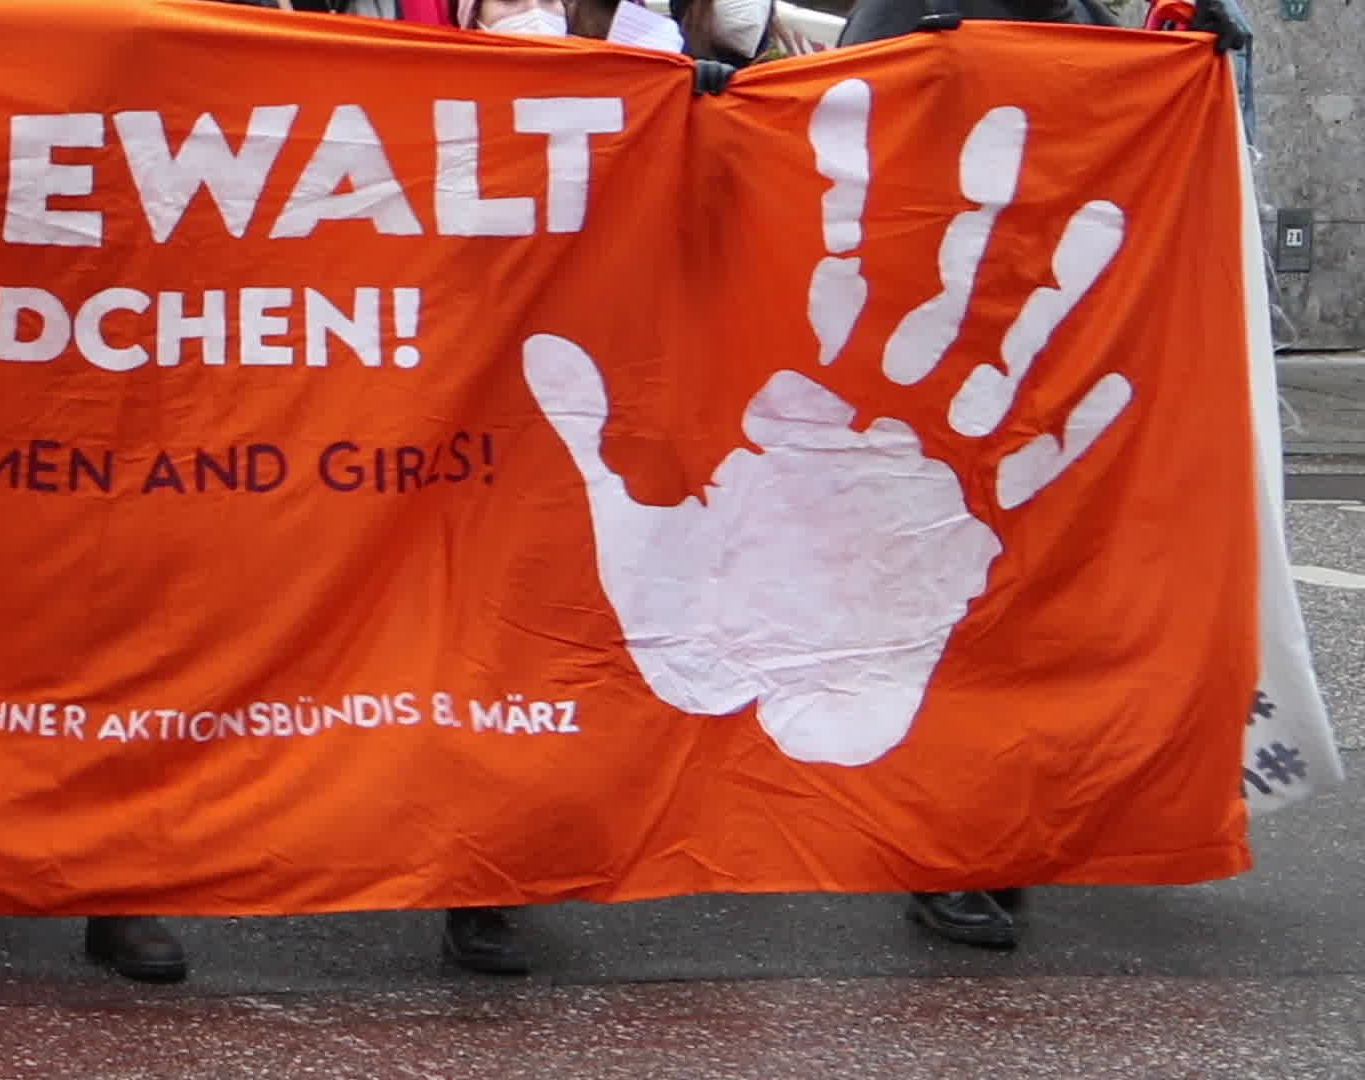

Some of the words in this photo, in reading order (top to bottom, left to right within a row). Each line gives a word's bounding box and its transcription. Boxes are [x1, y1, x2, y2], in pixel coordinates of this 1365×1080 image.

[139, 442, 288, 494] AND
[316, 428, 496, 494] GIRLS!
[96, 691, 422, 743] AKTIONSBÜNDIS
[431, 692, 462, 729] 8.
[469, 694, 580, 733] MÄRZ
